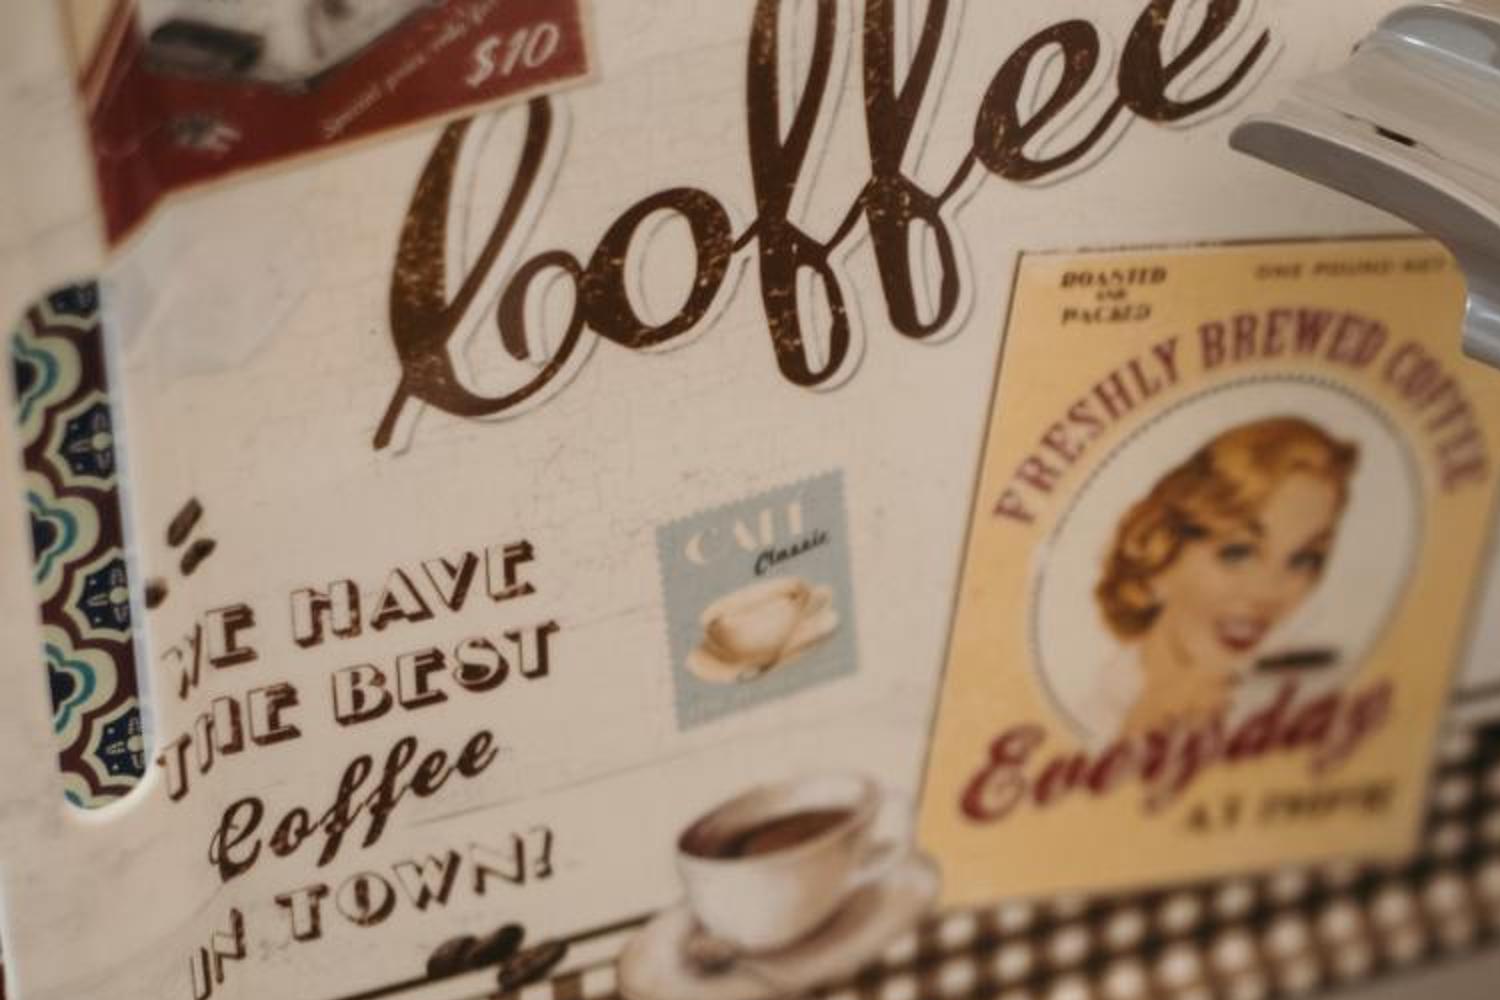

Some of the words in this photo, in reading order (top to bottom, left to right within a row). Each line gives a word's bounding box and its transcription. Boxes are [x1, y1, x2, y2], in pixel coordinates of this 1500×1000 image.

[466, 22, 560, 88] $10
[1060, 267, 1167, 290] ROASTED
[992, 336, 1179, 525] FRESHLY
[1197, 308, 1388, 370] BREWED
[1384, 341, 1490, 493] COFFEE
[161, 602, 258, 701] WE
[290, 539, 536, 650] HAVE
[156, 681, 302, 803] THE
[330, 619, 561, 726] BEST
[960, 680, 1393, 823] Everyday
[208, 729, 500, 884] Coffee
[274, 827, 554, 943] TOWN!
